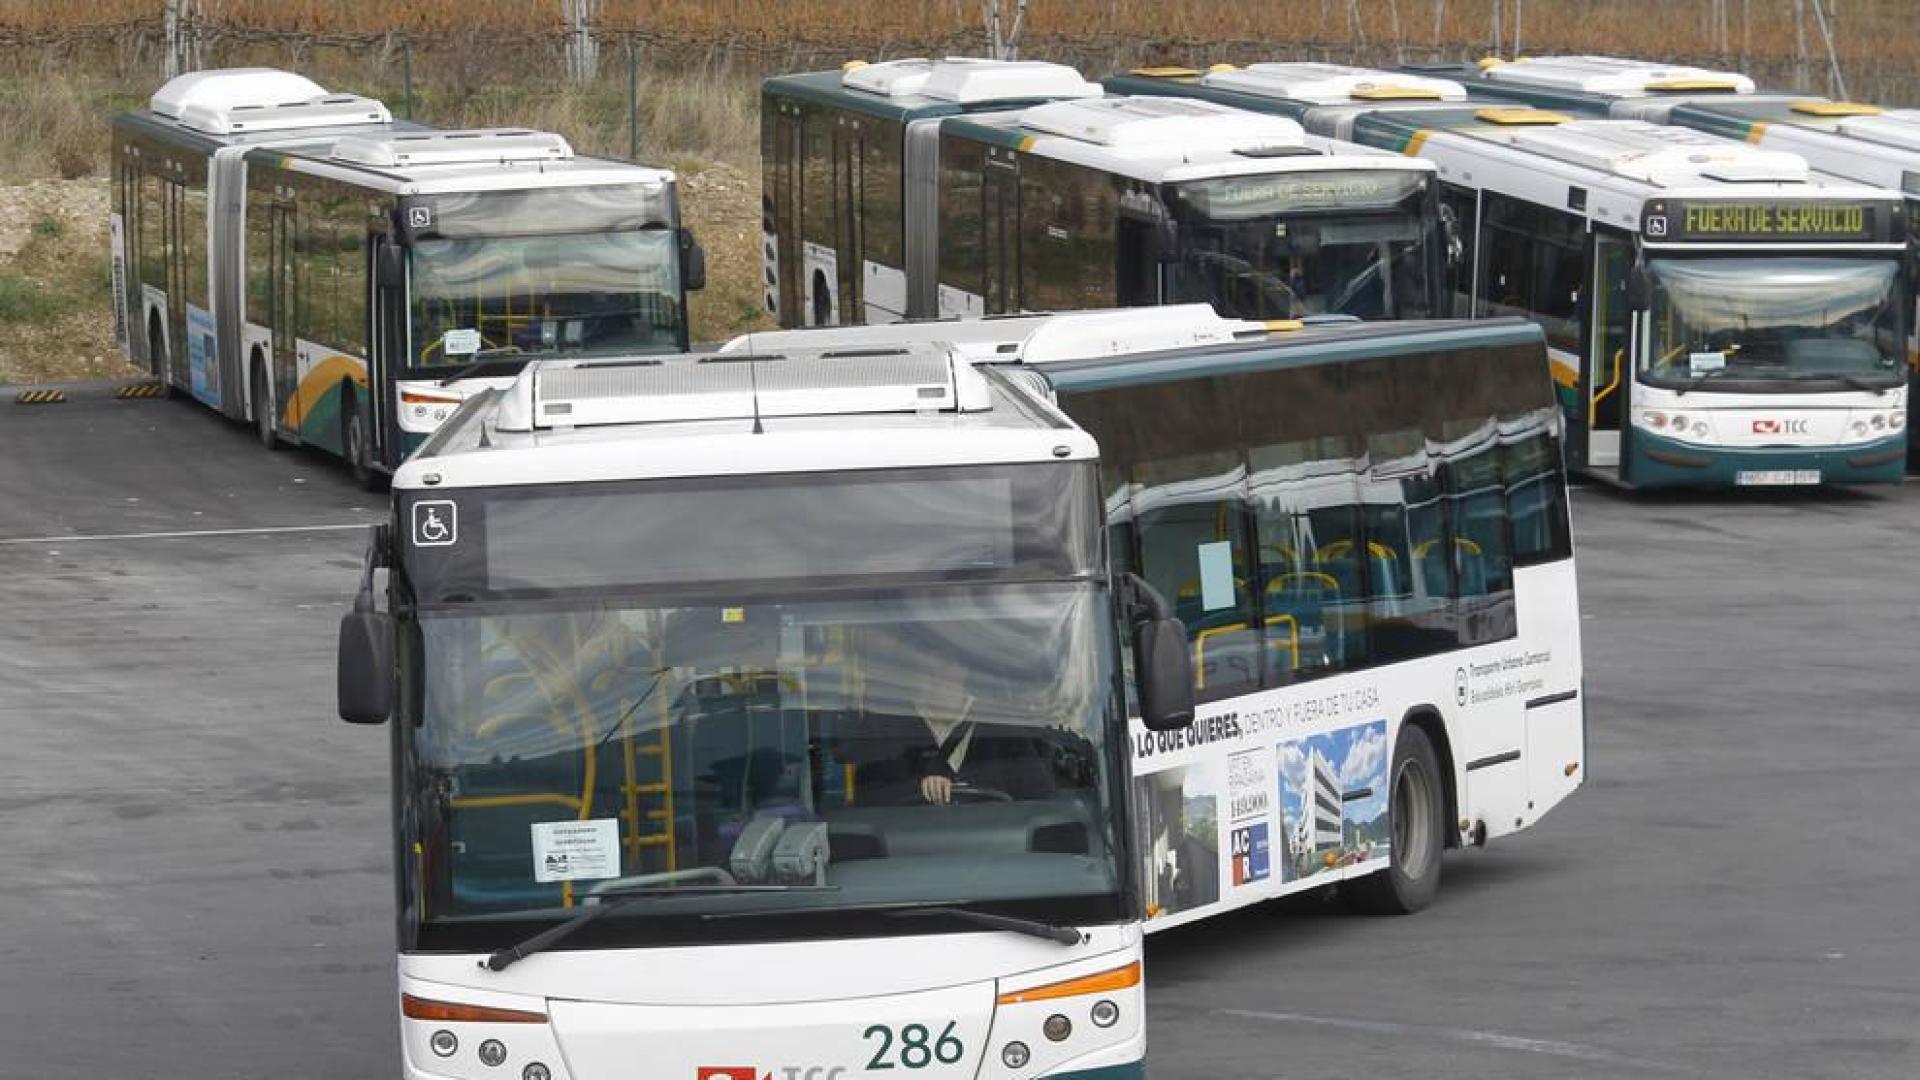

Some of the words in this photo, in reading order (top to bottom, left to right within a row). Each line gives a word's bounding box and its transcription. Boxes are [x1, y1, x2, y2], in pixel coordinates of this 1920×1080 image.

[1686, 206, 1744, 232] FUERA
[1750, 206, 1771, 232] DE
[1776, 206, 1862, 232] SERVICIO
[1784, 419, 1808, 433] TCC
[1137, 731, 1154, 758] LO
[1157, 728, 1184, 754] QUE
[1186, 711, 1243, 747] QUIERES,
[1244, 706, 1283, 733] DENTRO
[1293, 698, 1325, 721] FUERA
[1326, 695, 1339, 717] DE
[1340, 692, 1354, 713] TU
[1355, 686, 1380, 711] CASA
[862, 1020, 965, 1071] 286
